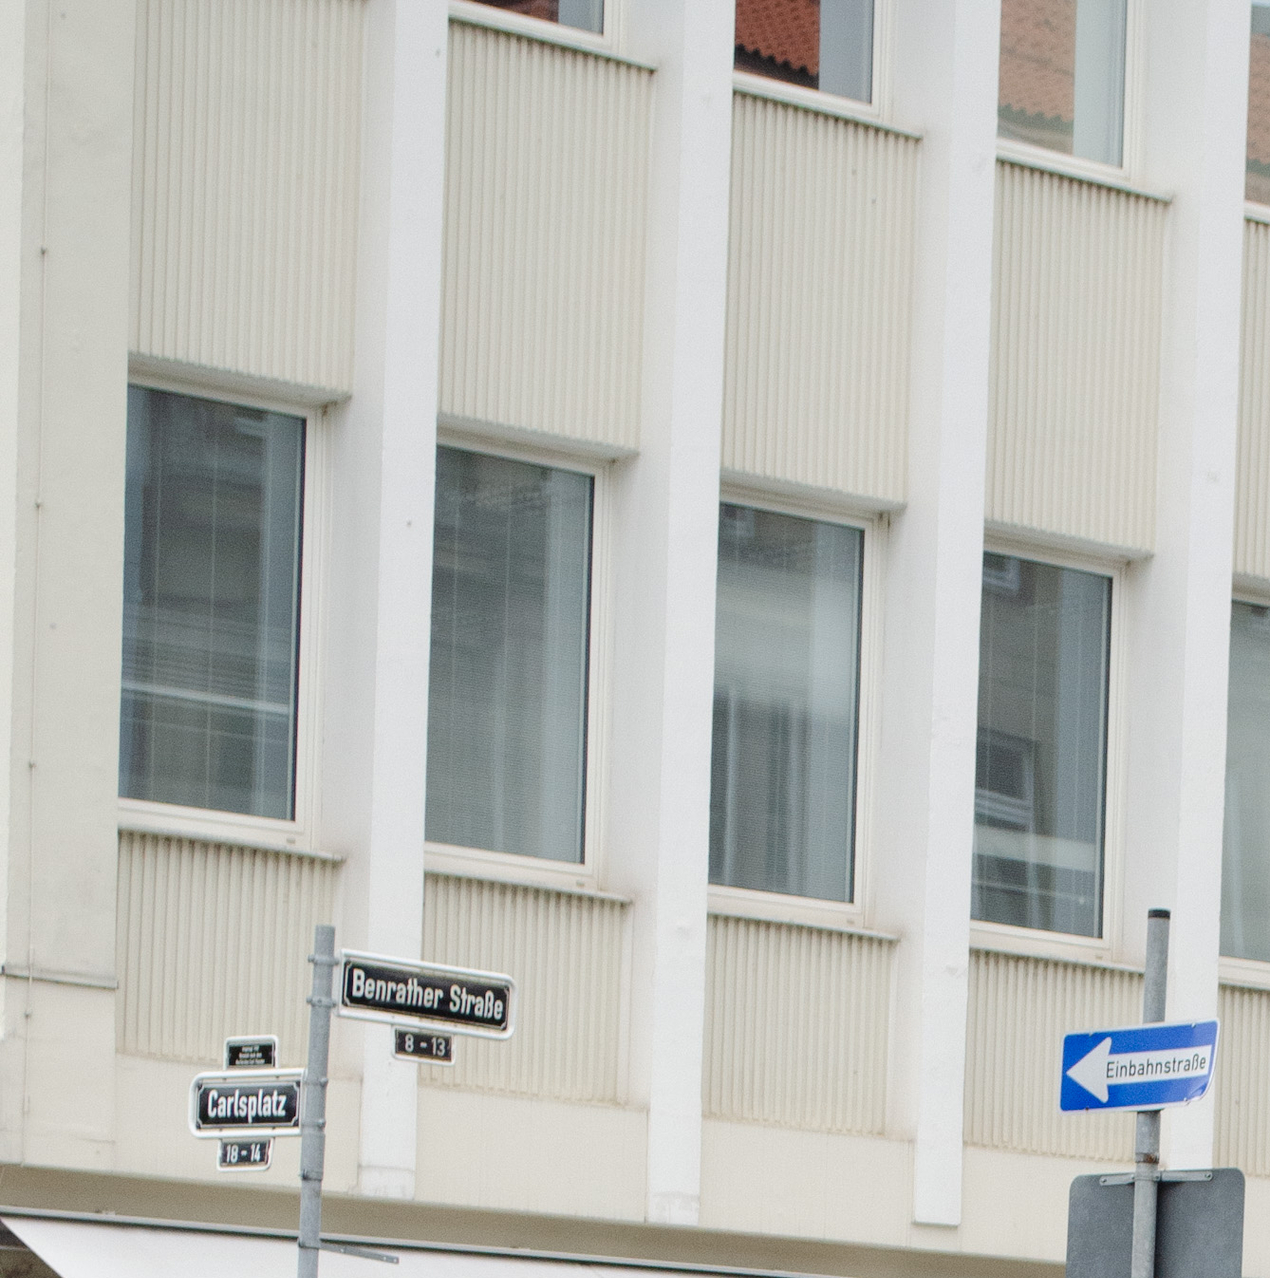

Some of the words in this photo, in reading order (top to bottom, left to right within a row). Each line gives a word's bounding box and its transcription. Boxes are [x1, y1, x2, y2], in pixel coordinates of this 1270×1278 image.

[351, 968, 444, 1010] Benrather
[449, 985, 505, 1021] Straße
[404, 1033, 415, 1053] 8
[432, 1037, 447, 1057] 13
[1106, 1053, 1207, 1079] Einbahnstraße
[207, 1088, 287, 1124] Carlsplatz
[226, 1143, 239, 1163] 18
[250, 1143, 262, 1163] 14
